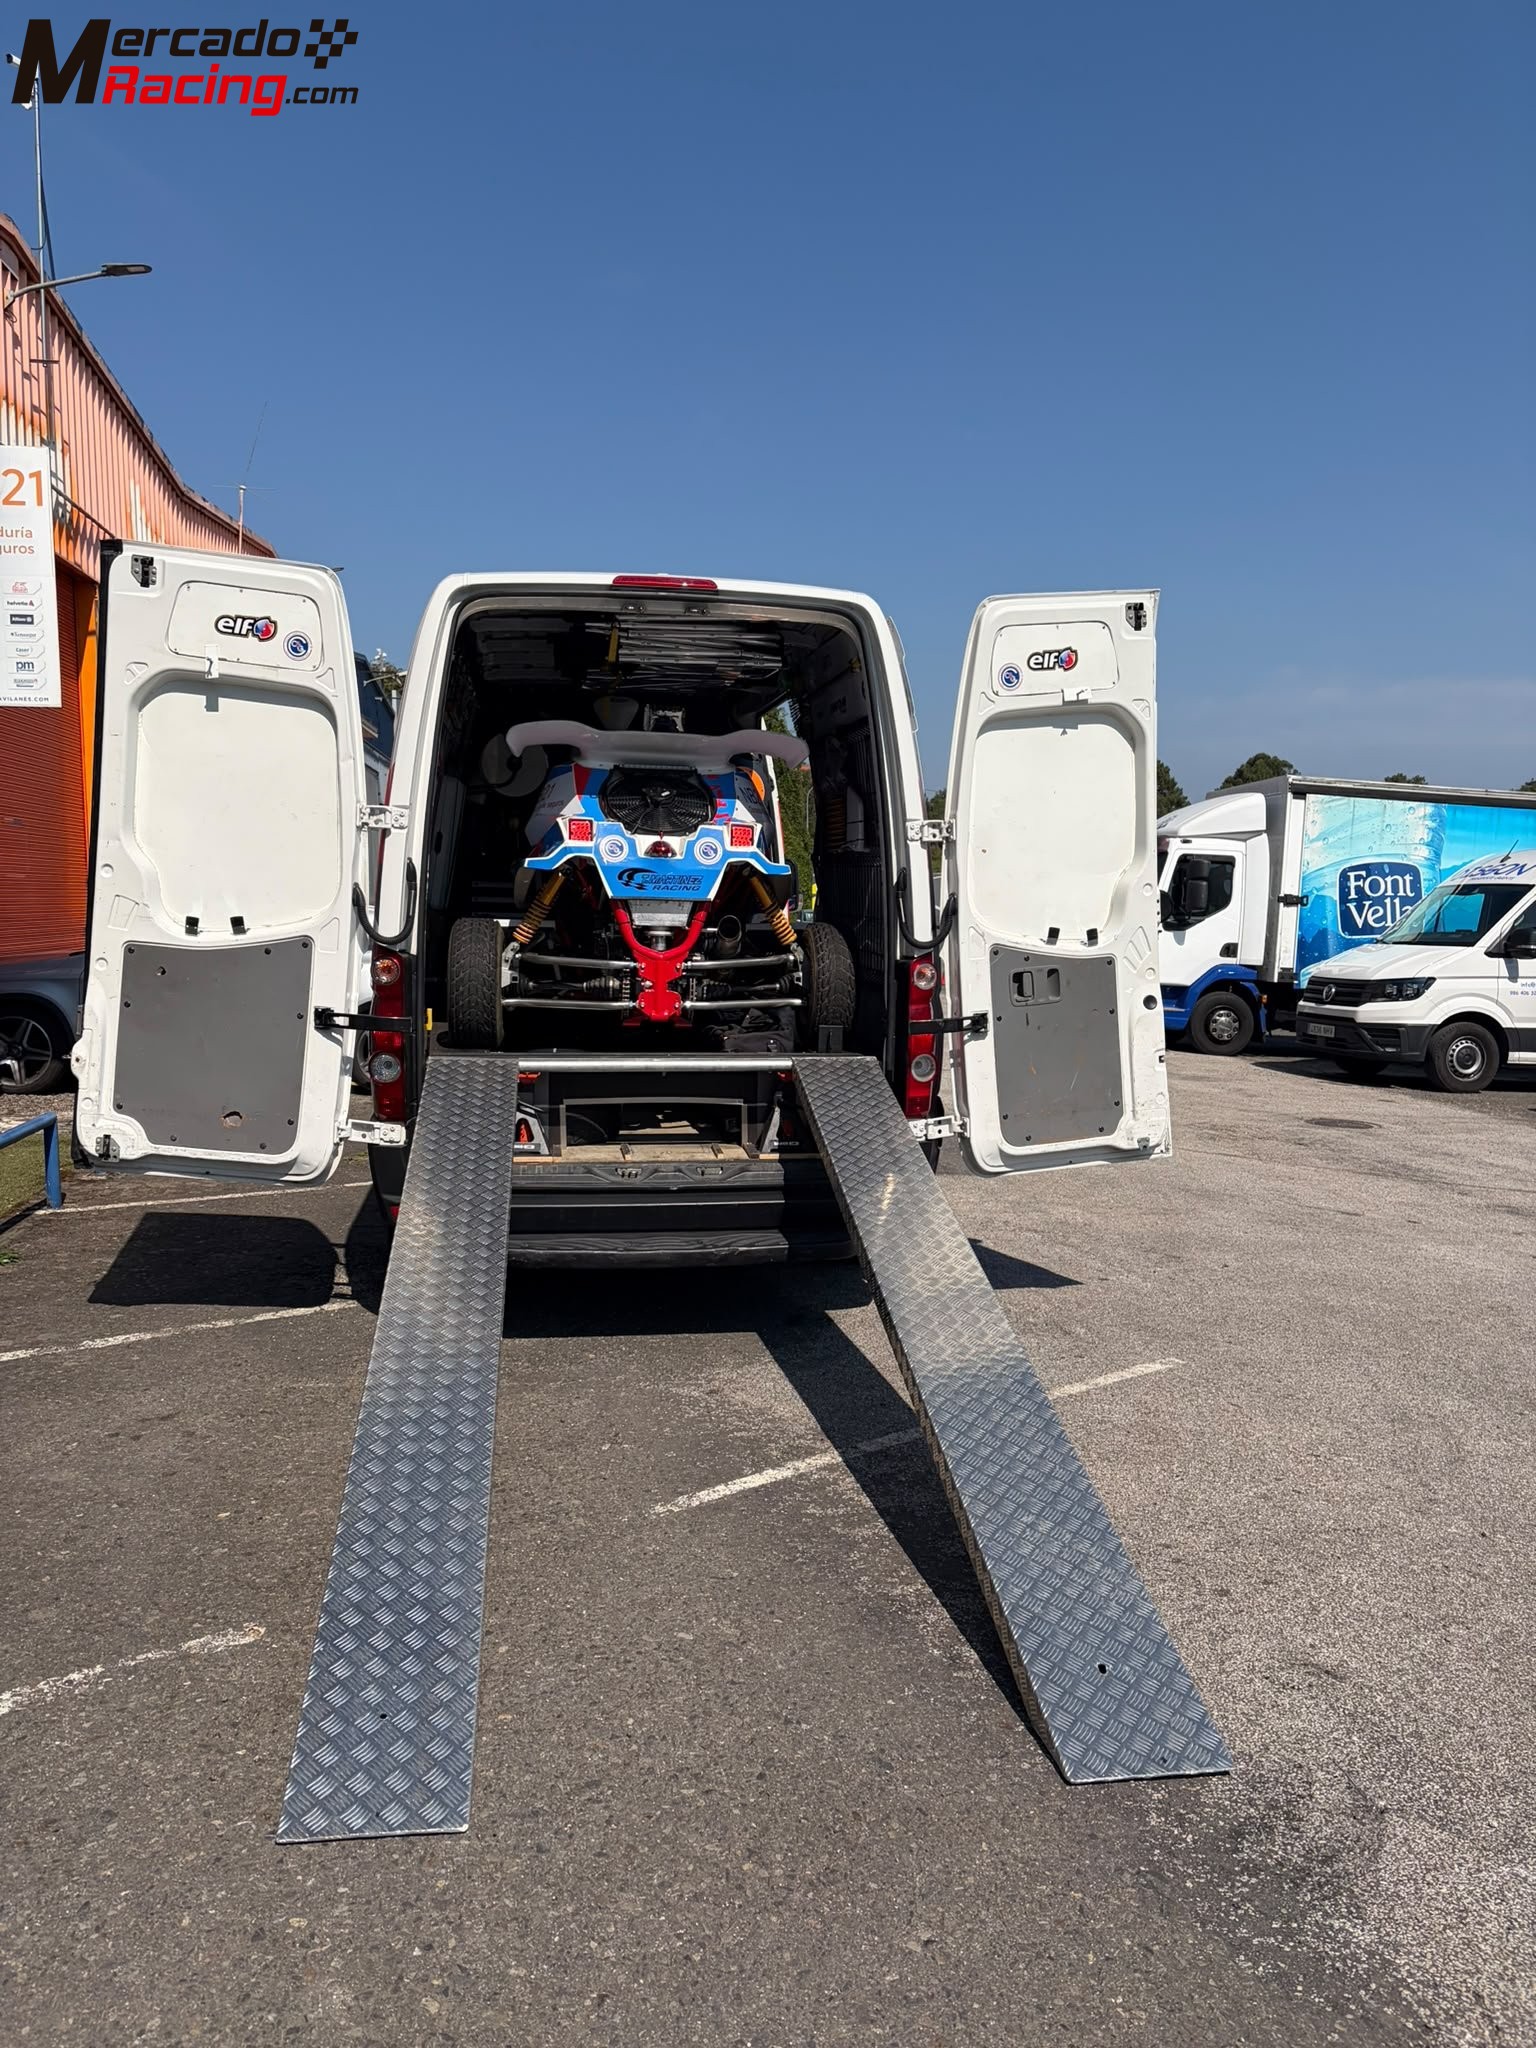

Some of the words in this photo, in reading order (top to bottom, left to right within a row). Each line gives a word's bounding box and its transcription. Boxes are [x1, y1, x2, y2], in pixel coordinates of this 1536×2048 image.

[217, 617, 254, 635] elf
[1029, 652, 1059, 669] elf
[1346, 871, 1415, 900] Font
